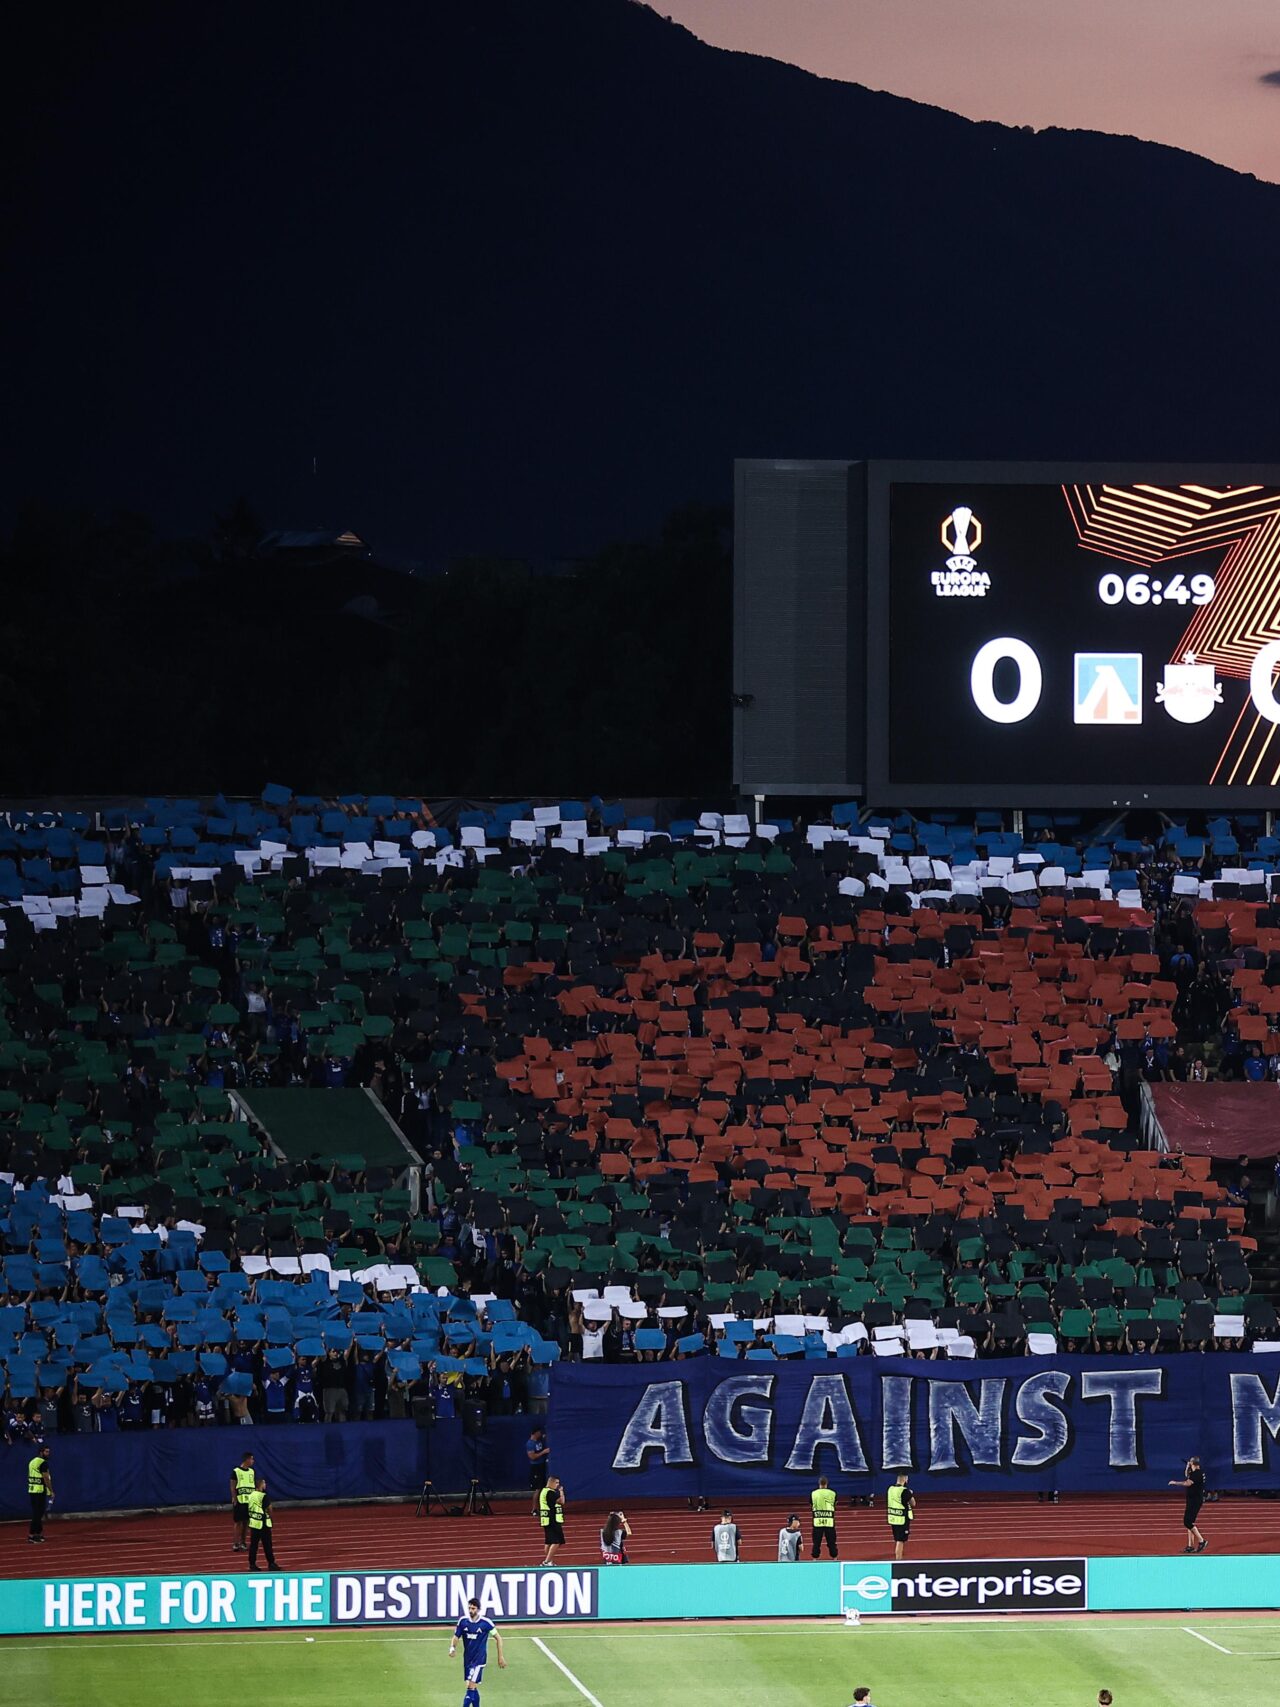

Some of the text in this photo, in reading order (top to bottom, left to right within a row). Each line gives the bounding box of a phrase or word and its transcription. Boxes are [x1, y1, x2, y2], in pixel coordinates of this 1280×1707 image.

[931, 571, 991, 586] EUROPA
[936, 584, 987, 597] LEAGUE
[1098, 573, 1216, 606] 06:49
[970, 637, 1042, 724] 0
[611, 1368, 1163, 1473] AGAINST
[44, 1572, 591, 1627] HERE FOR THE DESTINATION
[857, 1569, 1082, 1603] enterprise
